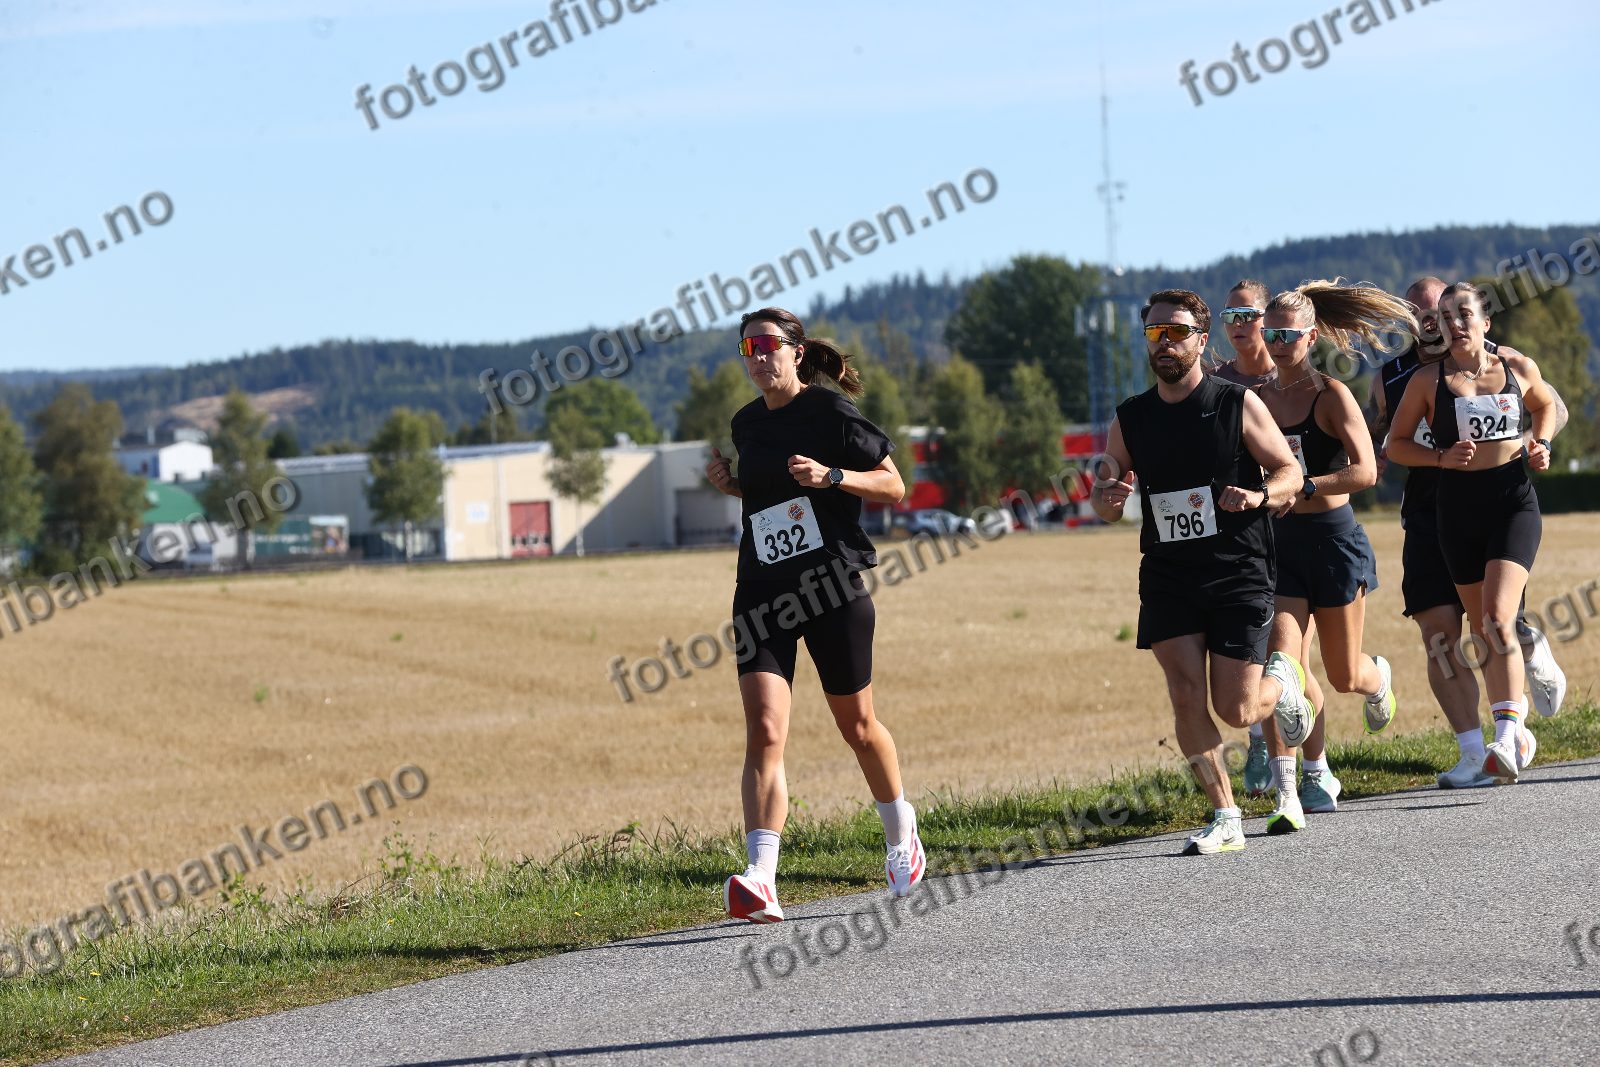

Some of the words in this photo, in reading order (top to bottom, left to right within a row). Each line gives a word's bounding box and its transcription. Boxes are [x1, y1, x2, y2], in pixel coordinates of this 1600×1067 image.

[1469, 415, 1508, 440] 324
[1164, 511, 1205, 539] 796
[764, 523, 810, 562] 332
